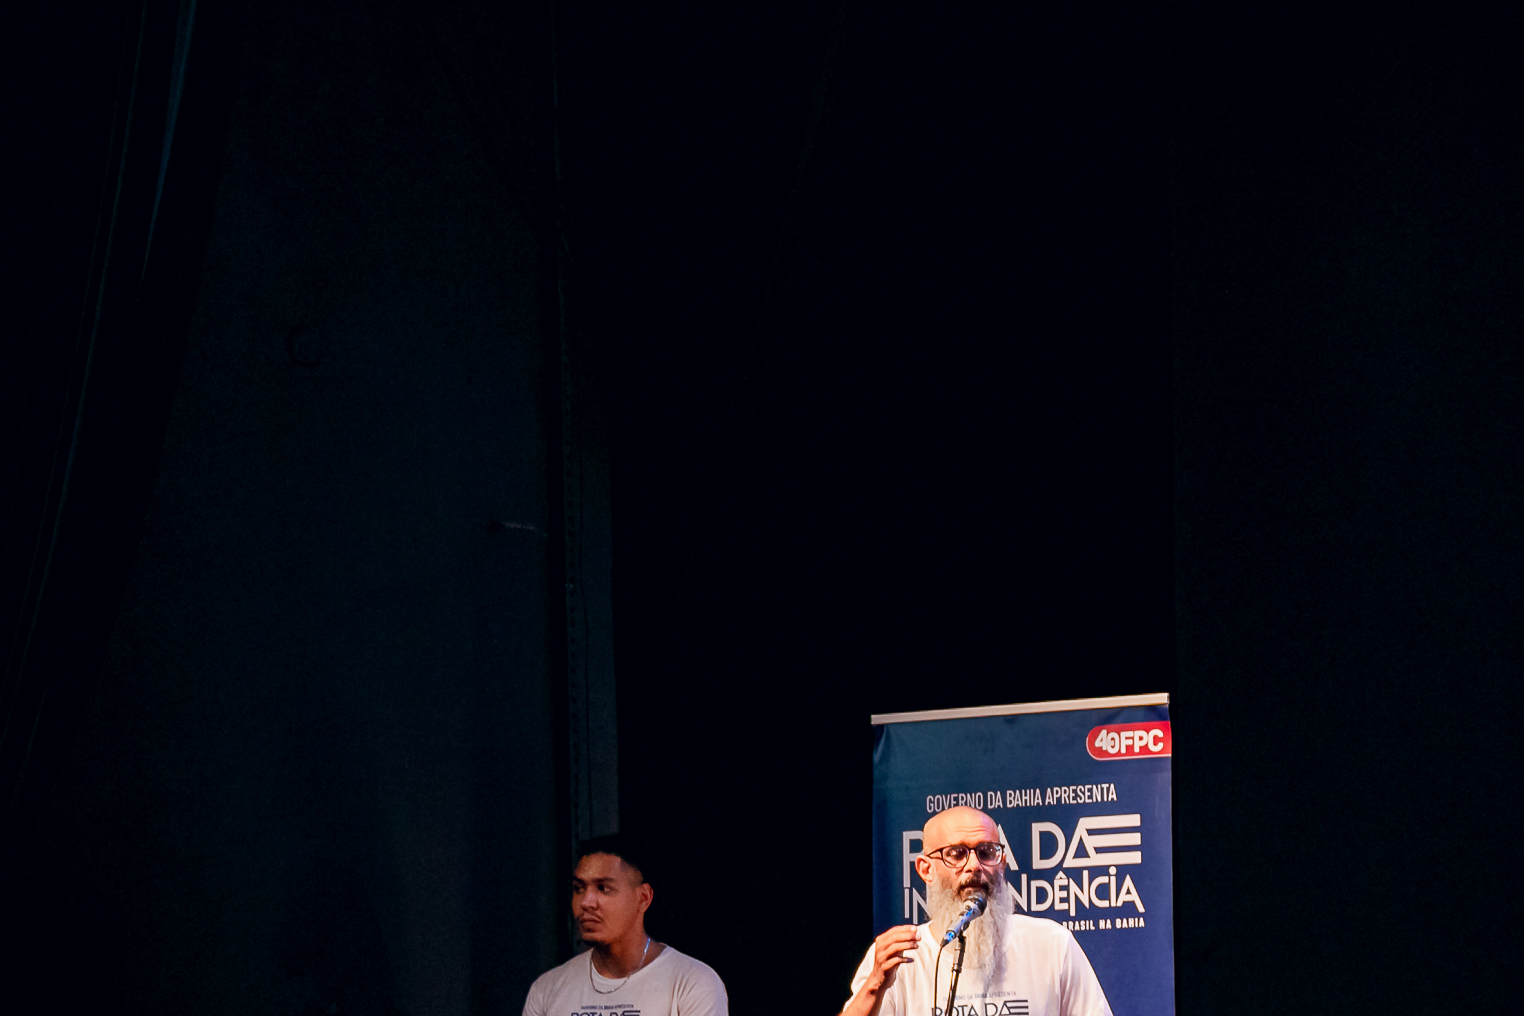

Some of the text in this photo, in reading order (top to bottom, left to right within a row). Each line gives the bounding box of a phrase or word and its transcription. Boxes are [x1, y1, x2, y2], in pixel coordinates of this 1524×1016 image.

[926, 783, 1118, 814] GOVERNO DA BAHIA APRESENTA
[1099, 918, 1112, 930] NA
[1115, 917, 1145, 929] BAHIA
